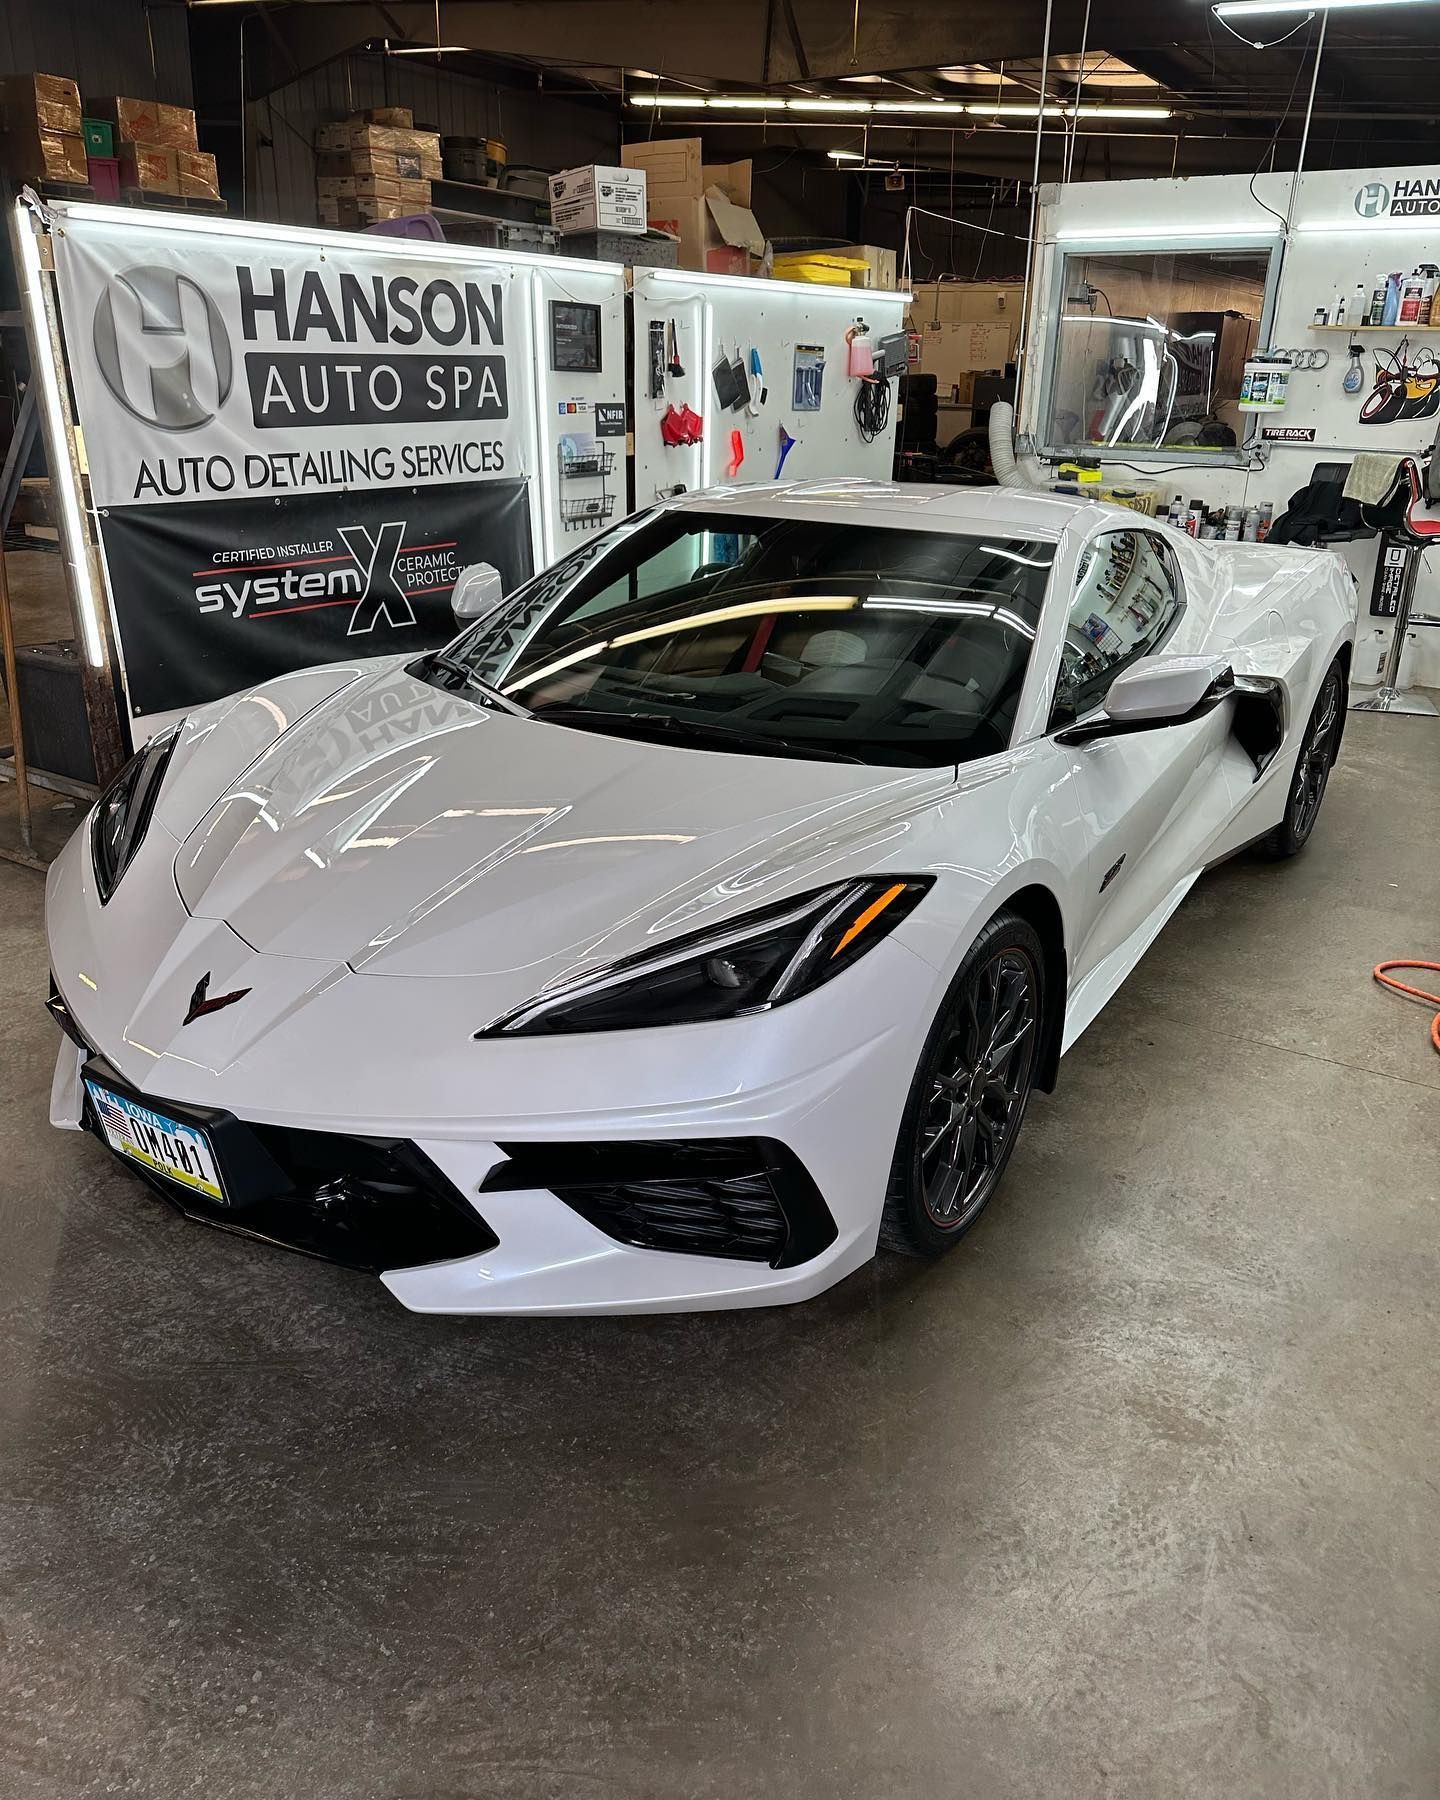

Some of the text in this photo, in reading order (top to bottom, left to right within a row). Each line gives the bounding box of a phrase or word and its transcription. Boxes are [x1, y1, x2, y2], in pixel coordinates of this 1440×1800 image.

[1392, 200, 1440, 214] AUTO
[236, 265, 504, 347] HANSON
[261, 364, 503, 415] AUTO SPA
[1265, 429, 1313, 441] TIRE RACK
[134, 440, 505, 499] AUTO DETAILING SERVICES
[212, 540, 334, 564] CERTIFIED INSTALLER
[397, 551, 456, 573] CERAMIC
[406, 565, 466, 588] PROTECT
[124, 1102, 163, 1128] IOWA
[152, 1158, 174, 1176] POLK
